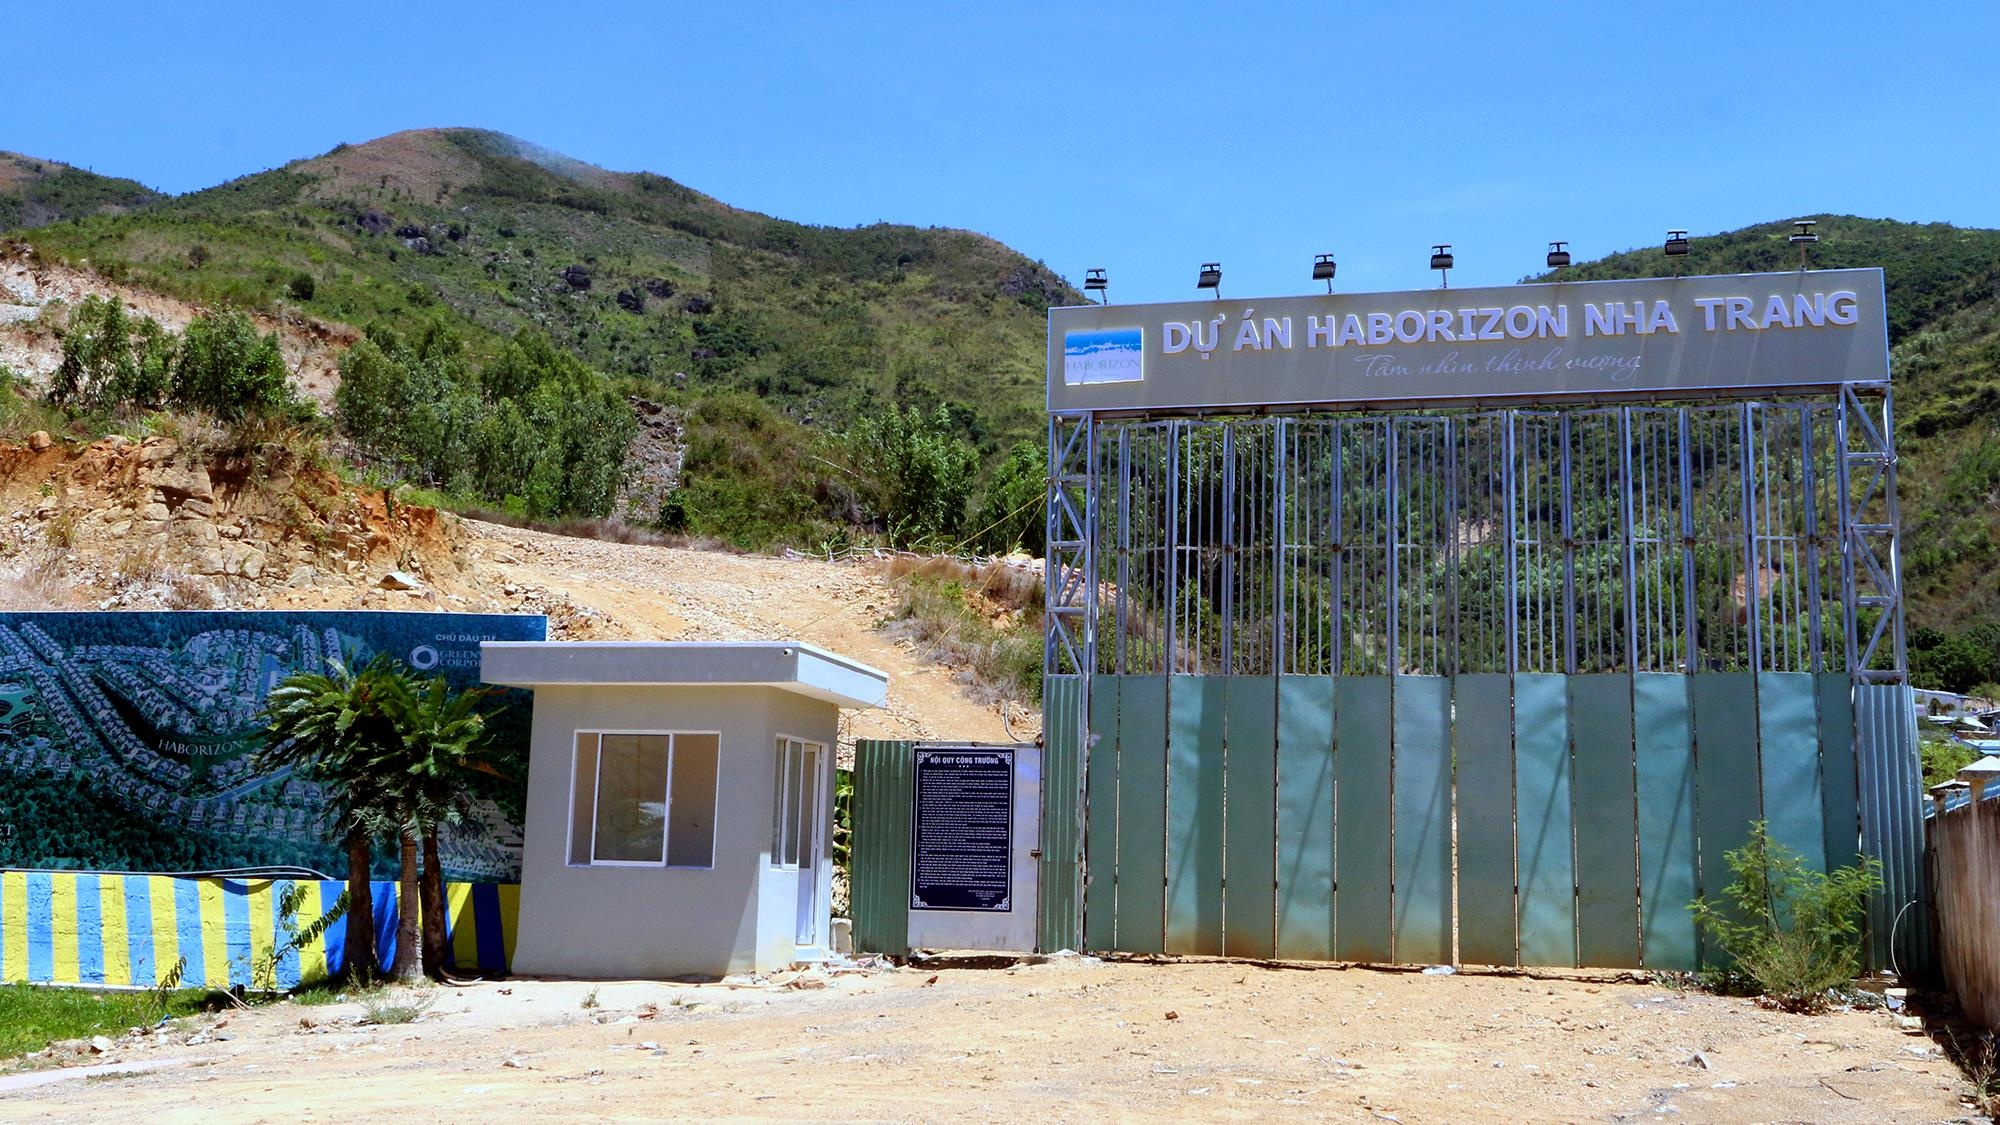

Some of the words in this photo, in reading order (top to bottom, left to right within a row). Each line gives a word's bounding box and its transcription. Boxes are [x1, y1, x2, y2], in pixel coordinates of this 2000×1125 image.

[1163, 312, 1225, 360] DỰ
[1233, 308, 1292, 351] ÁN
[1307, 304, 1568, 348] HABORIZON
[1584, 300, 1680, 337] NHA
[1693, 290, 1859, 332] TRANG
[1066, 359, 1141, 372] HABORIZON
[1354, 353, 1409, 377] Tầm
[1418, 351, 1477, 376] nhìn
[1485, 347, 1563, 376] thịnh
[1564, 354, 1641, 382] vượng
[158, 739, 243, 756] HABORIZON
[930, 755, 941, 765] NỘI
[942, 756, 954, 764] QUY
[956, 756, 973, 764] CÔNG
[974, 756, 999, 764] TRƯỜNG
